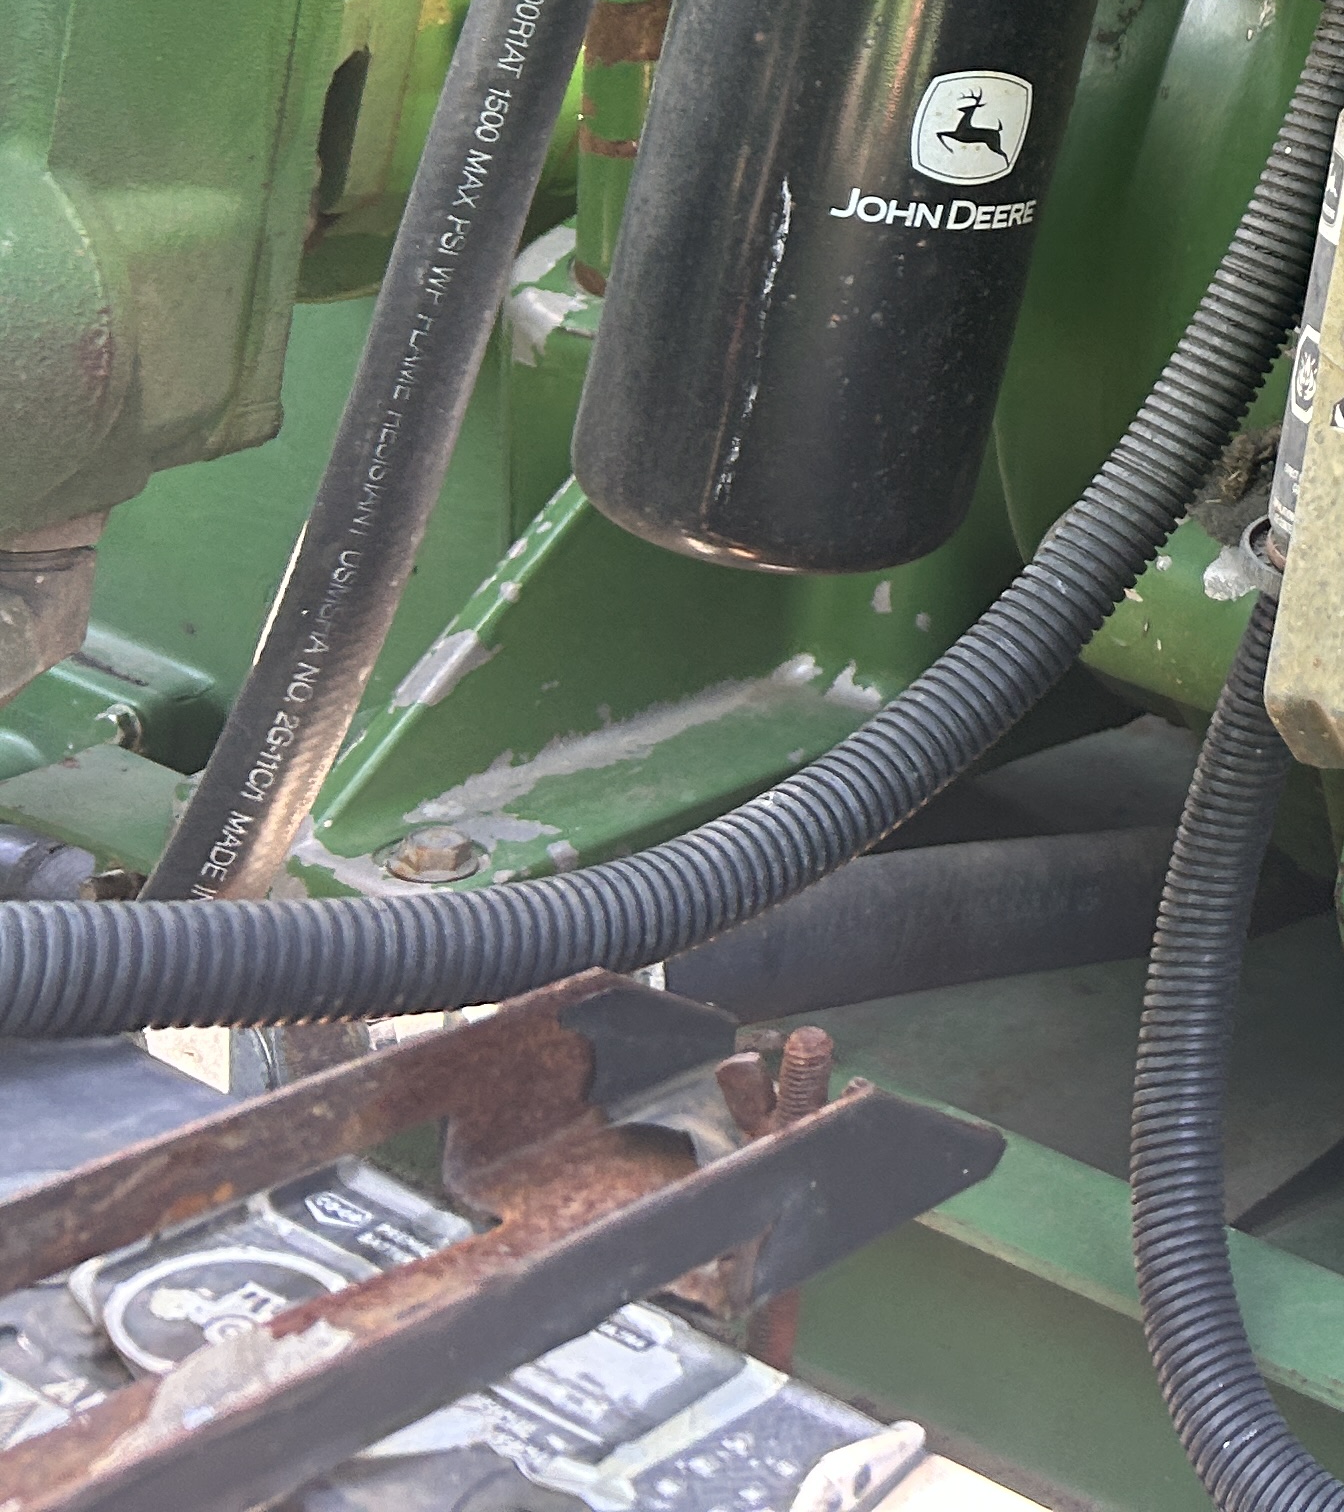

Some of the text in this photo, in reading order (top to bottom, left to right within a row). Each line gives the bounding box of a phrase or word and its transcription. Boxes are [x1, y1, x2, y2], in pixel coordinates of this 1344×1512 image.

[471, 83, 515, 145] 1500
[449, 147, 493, 212] MAX
[830, 188, 1038, 230] JOHN DEERE
[435, 213, 471, 259] PSI
[199, 810, 253, 882] MADE
